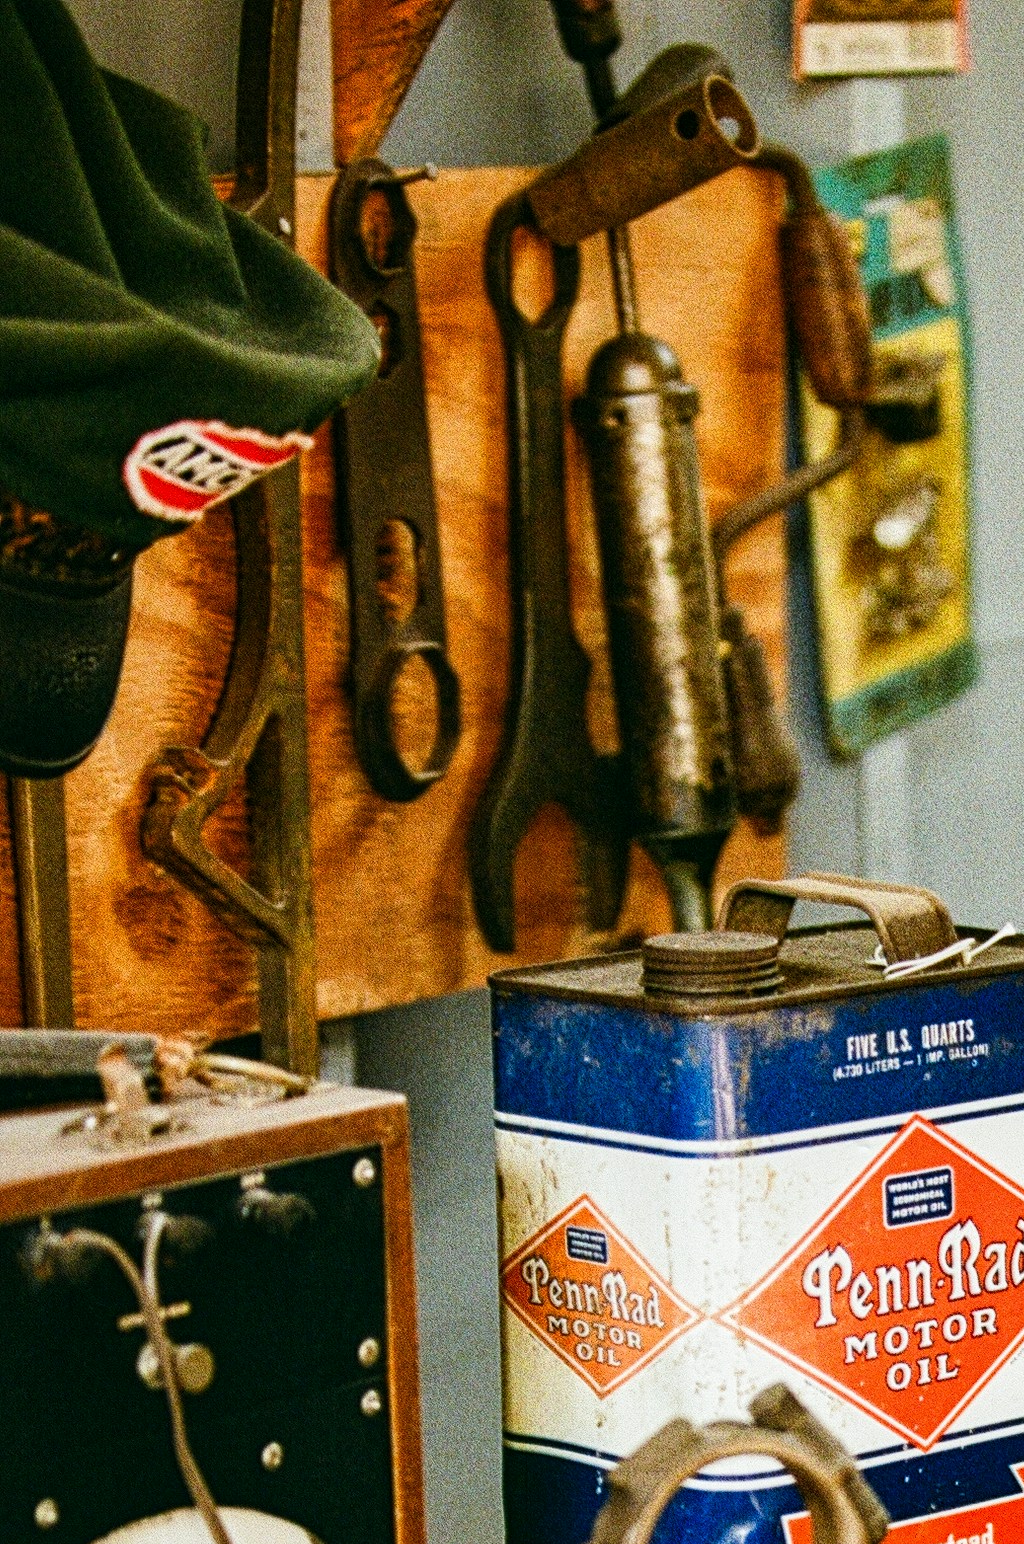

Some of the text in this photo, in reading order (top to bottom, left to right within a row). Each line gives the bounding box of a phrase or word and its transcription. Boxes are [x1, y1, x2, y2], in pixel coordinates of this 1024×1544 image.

[846, 1018, 976, 1062] FIVE U.S. QUARTS
[865, 1057, 901, 1075] LITERS
[926, 1050, 946, 1064] IMP.
[948, 1043, 990, 1061] GALLON)
[891, 1201, 948, 1219] MOTOR OIL
[546, 1314, 643, 1351] MOTOR
[843, 1306, 999, 1365] MOTOR
[575, 1341, 622, 1367] OIL
[885, 1353, 960, 1391] OIL
